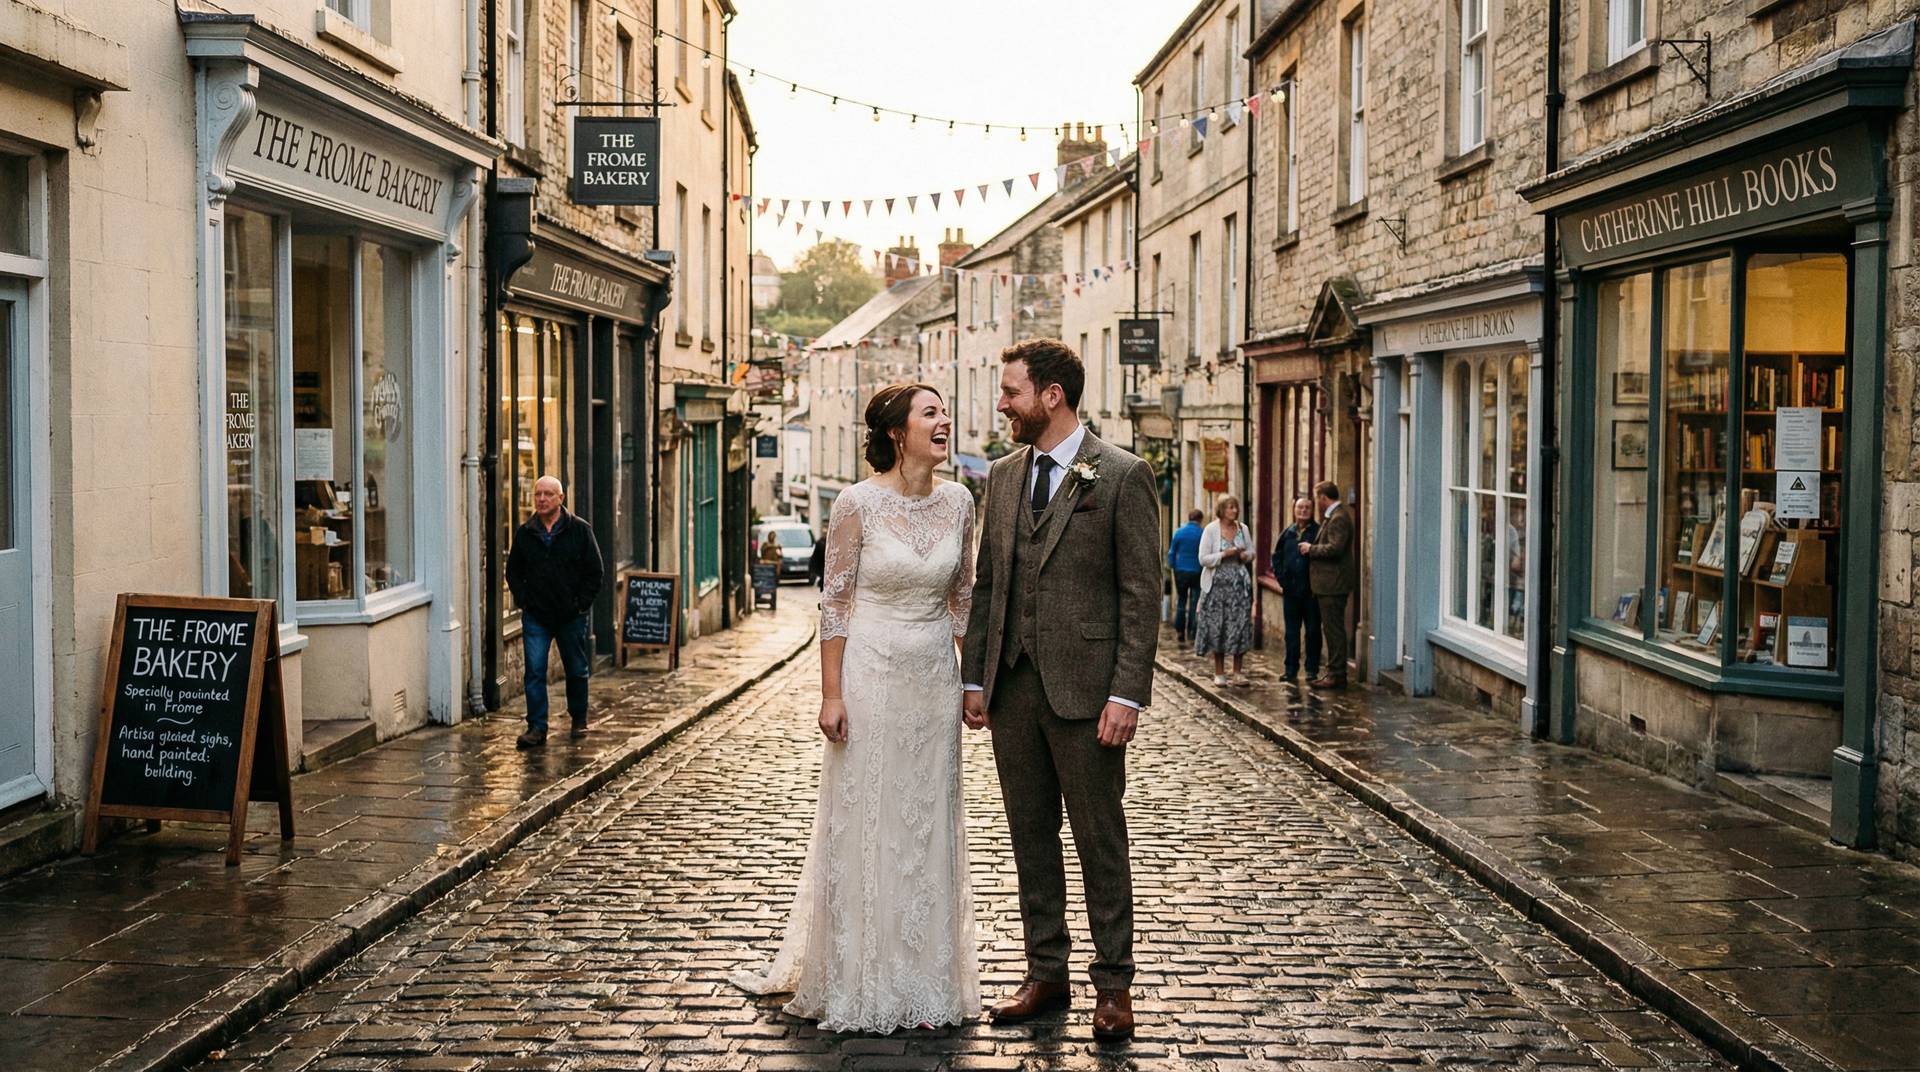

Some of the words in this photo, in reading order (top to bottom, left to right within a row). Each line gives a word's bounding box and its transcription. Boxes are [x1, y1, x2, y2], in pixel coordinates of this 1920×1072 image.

[599, 134, 635, 148] THE
[253, 109, 304, 169] THE
[304, 131, 376, 193] FROME
[376, 159, 443, 214] BAKERY
[587, 152, 647, 167] FROME
[583, 171, 650, 185] BAKERY
[1580, 192, 1684, 253] CATHERINE
[1685, 176, 1740, 226] HILL
[1742, 146, 1837, 212] BOOKS
[551, 263, 572, 294] THE
[568, 269, 600, 301] FROME
[597, 278, 629, 309] BAKERY
[1419, 319, 1460, 345] CATHERINE
[1460, 315, 1482, 341] HILL
[1483, 310, 1514, 337] BOOKS
[230, 392, 249, 409] THE
[227, 433, 254, 449] AKERY
[133, 618, 176, 641] THE
[182, 620, 248, 646] FROME
[132, 647, 237, 682] BAKERY
[124, 684, 174, 700] Specially
[144, 699, 156, 711] in
[164, 700, 203, 714] Frome
[121, 744, 154, 760] hand
